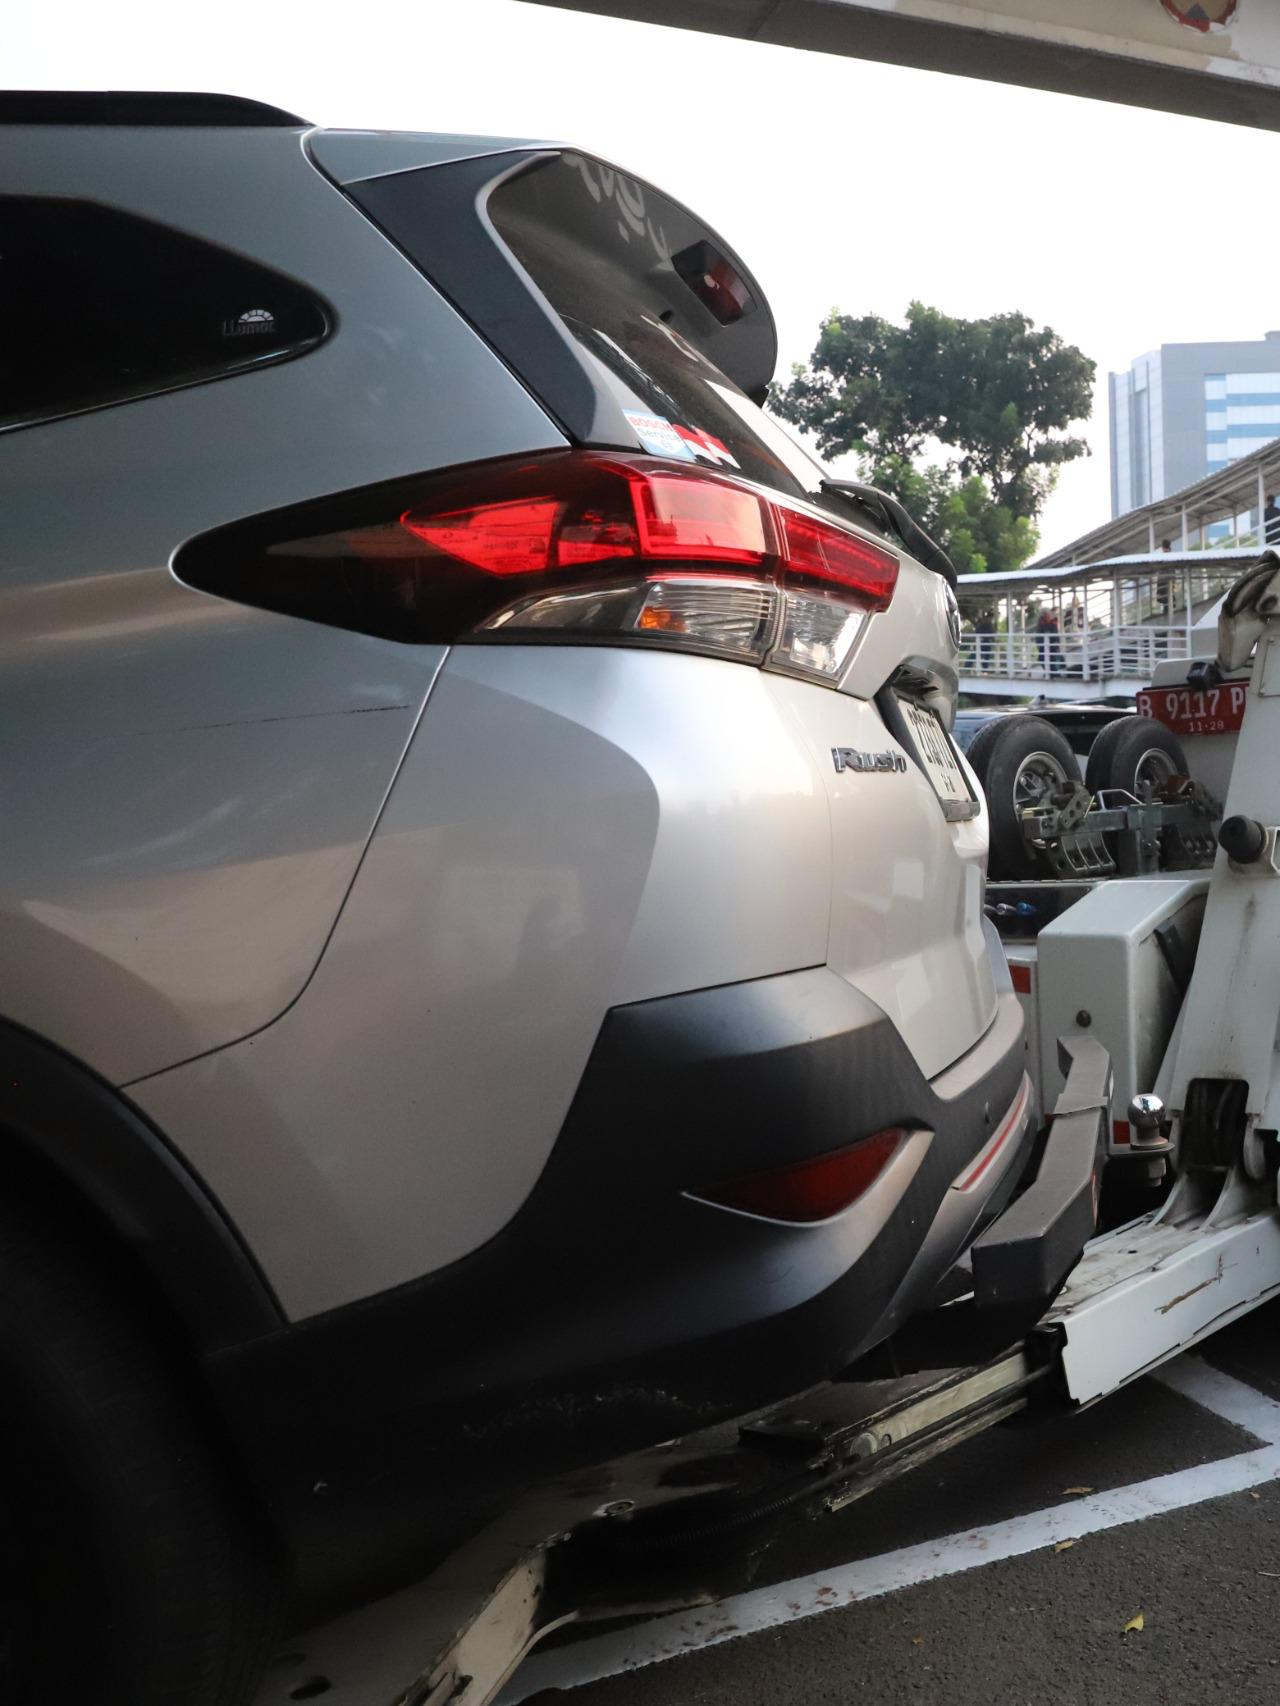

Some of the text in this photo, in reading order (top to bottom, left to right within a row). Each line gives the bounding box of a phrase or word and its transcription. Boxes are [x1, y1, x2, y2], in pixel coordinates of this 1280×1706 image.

[1138, 686, 1249, 720] B 9117 P
[831, 746, 907, 773] Rush
